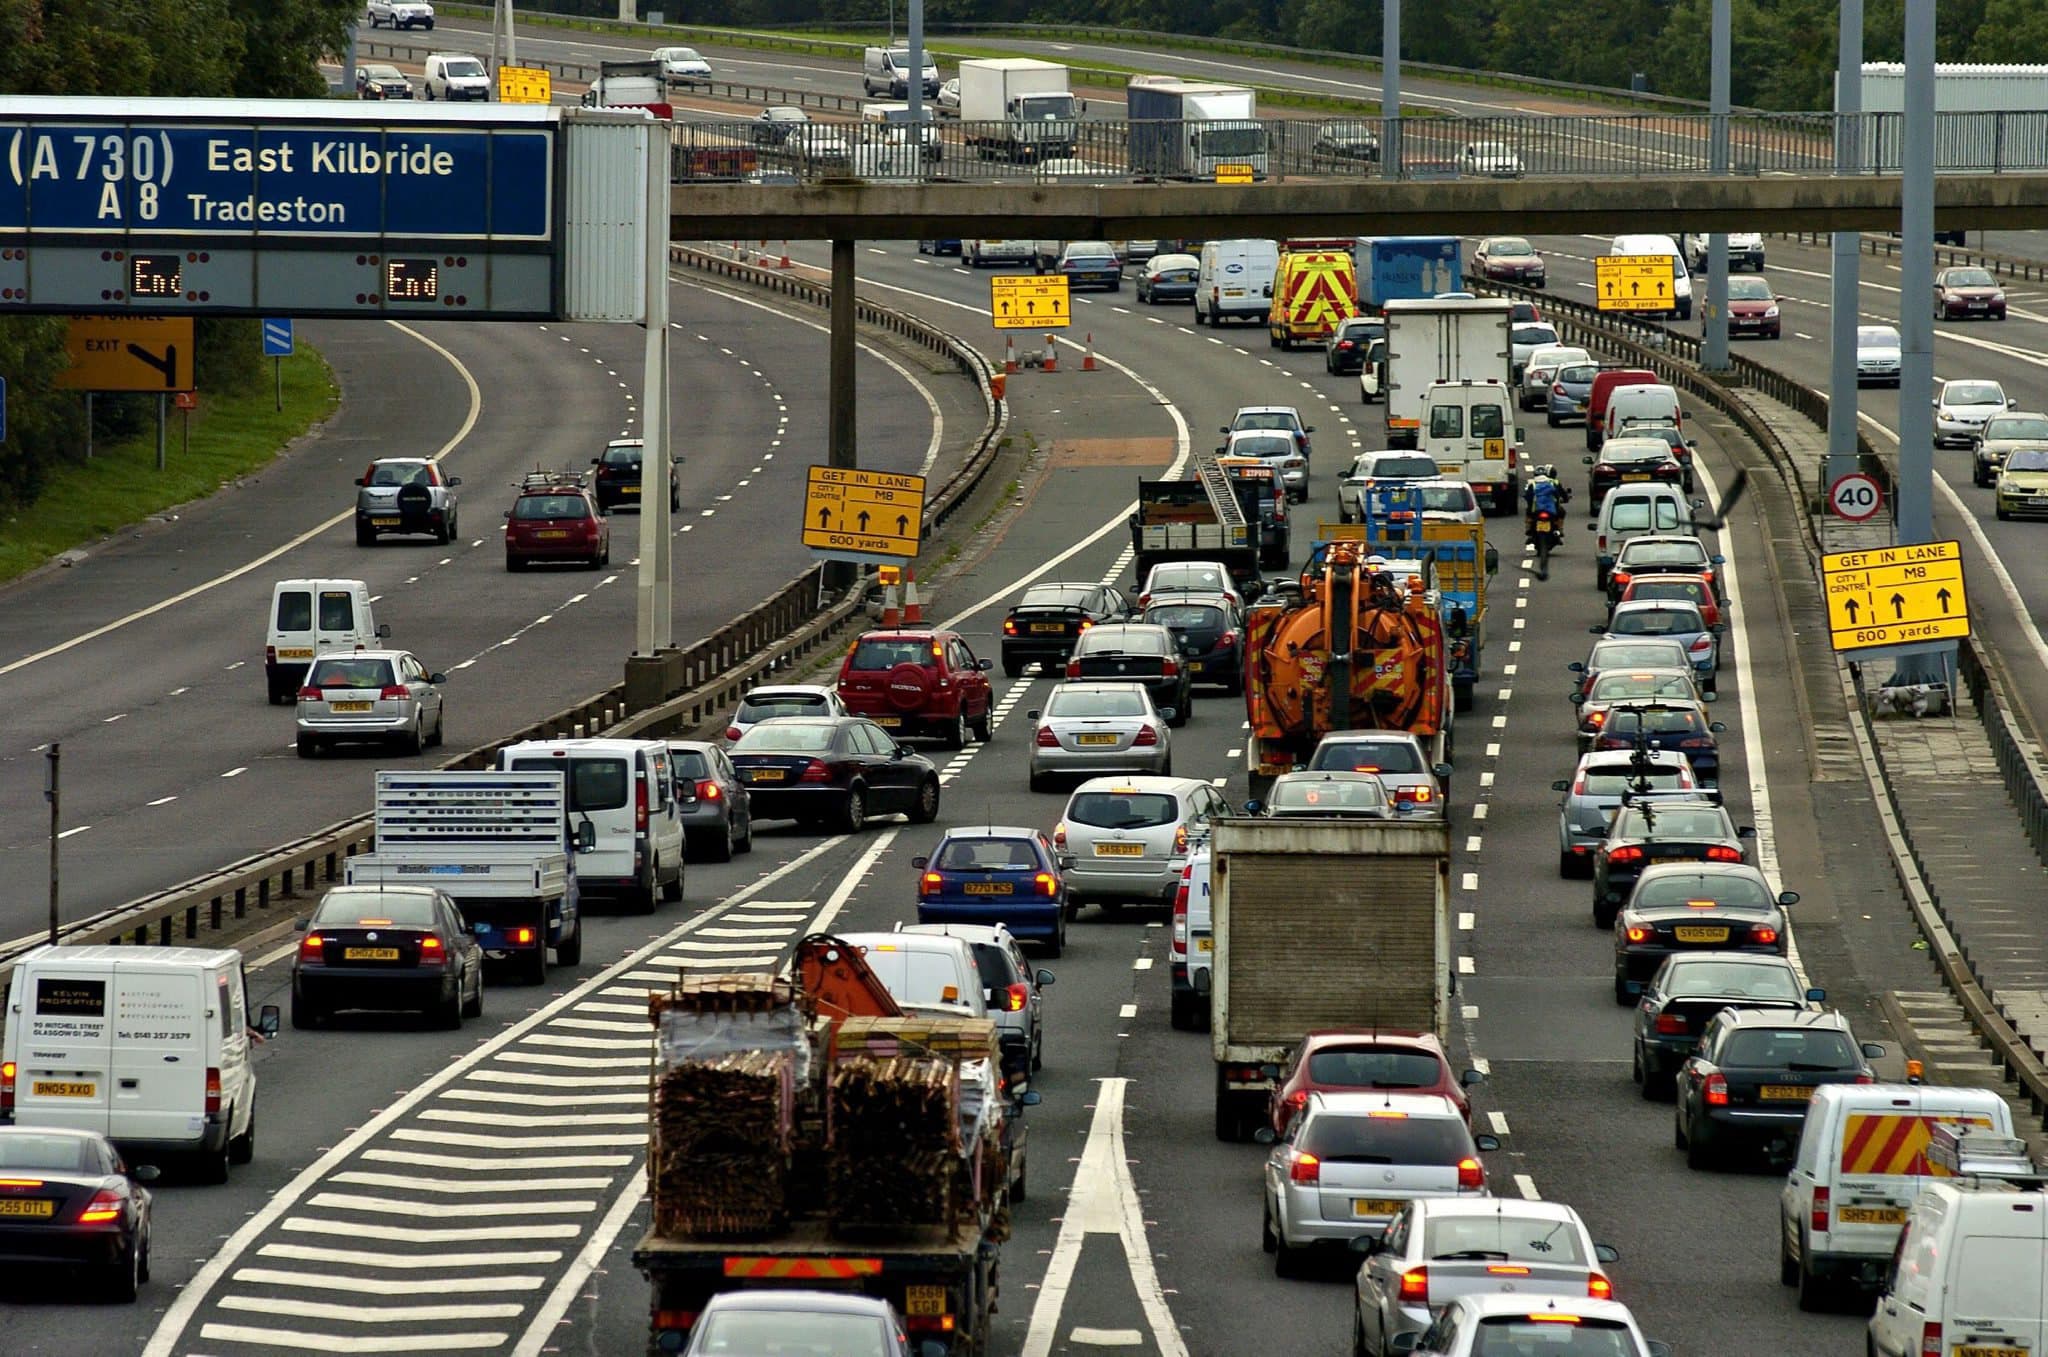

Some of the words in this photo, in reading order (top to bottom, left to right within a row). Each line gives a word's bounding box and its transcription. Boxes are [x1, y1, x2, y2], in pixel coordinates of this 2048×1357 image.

[73, 129, 174, 188] 730)
[208, 139, 294, 173] East
[312, 142, 454, 176] Kilbride
[97, 182, 122, 219] A
[140, 182, 159, 220] 8
[187, 194, 345, 223] Tradeston
[135, 260, 182, 293] End
[388, 263, 437, 296] End
[85, 339, 120, 352] EXIT
[821, 470, 847, 481] GET
[855, 473, 869, 484] IN
[877, 476, 911, 488] LANE
[1838, 487, 1873, 507] 40
[829, 535, 854, 546] 600
[858, 538, 889, 549] yards
[1840, 554, 1868, 567] GET
[1880, 551, 1896, 563] IN
[1906, 546, 1946, 560] LANE
[1836, 574, 1857, 583] CITY
[1904, 566, 1927, 579] M8
[1830, 582, 1866, 594] CENTRE
[1856, 629, 1887, 643] 600
[1899, 623, 1940, 640] yards
[890, 683, 922, 692] HONDA
[52, 990, 90, 998] KELVIN
[39, 997, 103, 1007] PROPERTIES
[33, 1029, 72, 1037] GLASGOW
[80, 1023, 104, 1031] STREET
[38, 1083, 66, 1095] BN05
[1844, 1209, 1874, 1221] SH57
